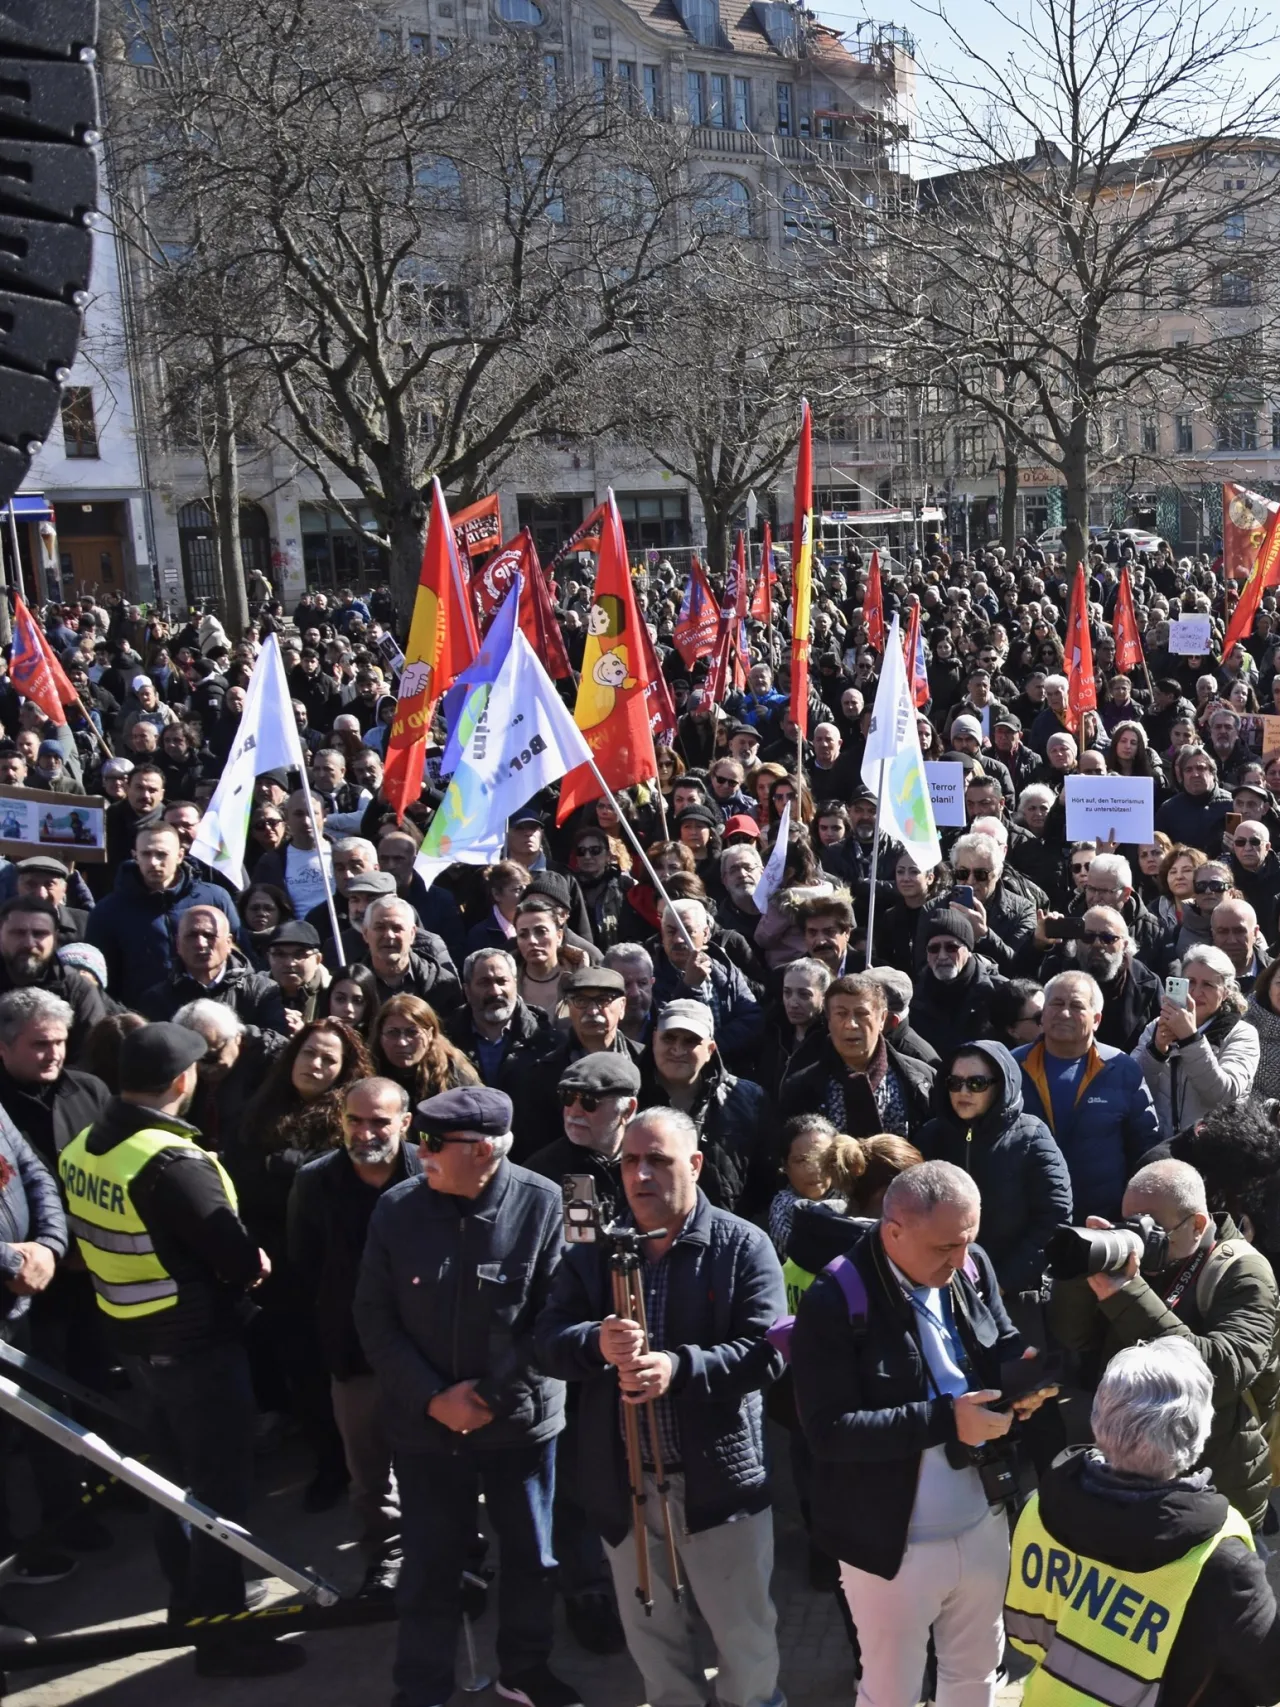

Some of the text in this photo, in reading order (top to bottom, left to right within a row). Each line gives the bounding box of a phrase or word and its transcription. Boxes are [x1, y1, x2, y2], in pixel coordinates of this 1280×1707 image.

[931, 782, 957, 792] Terror
[931, 795, 954, 804] olani!
[61, 1158, 126, 1216] ORDNER
[1167, 1284, 1184, 1302] EOS
